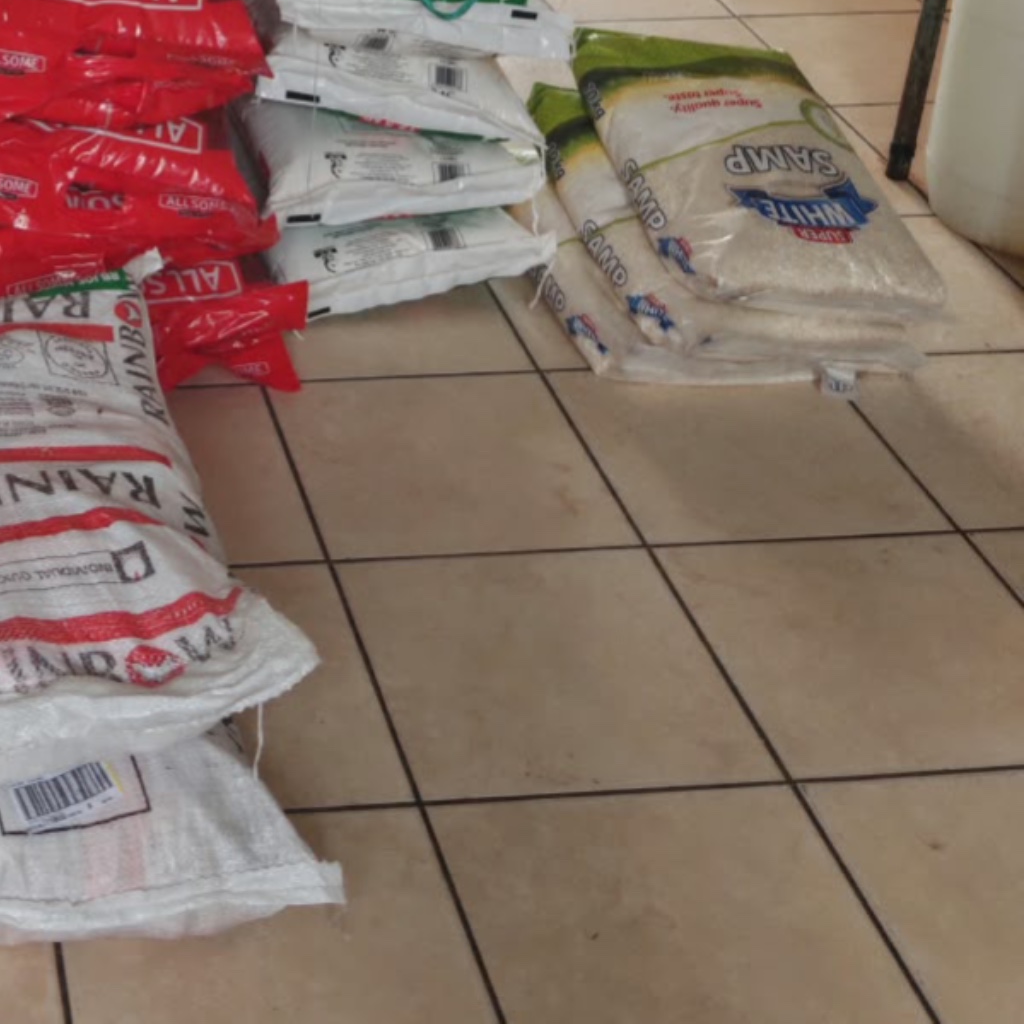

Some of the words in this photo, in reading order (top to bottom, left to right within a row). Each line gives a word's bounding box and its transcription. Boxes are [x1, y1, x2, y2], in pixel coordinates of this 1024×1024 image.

[670, 97, 722, 116] quality.
[723, 96, 763, 110] Super
[723, 144, 840, 178] SAMP
[621, 158, 667, 231] SAMP
[761, 199, 856, 227] WHITE
[798, 228, 846, 242] SUPER
[579, 219, 628, 287] SAMP
[37, 562, 113, 580] INDIVIDUAL
